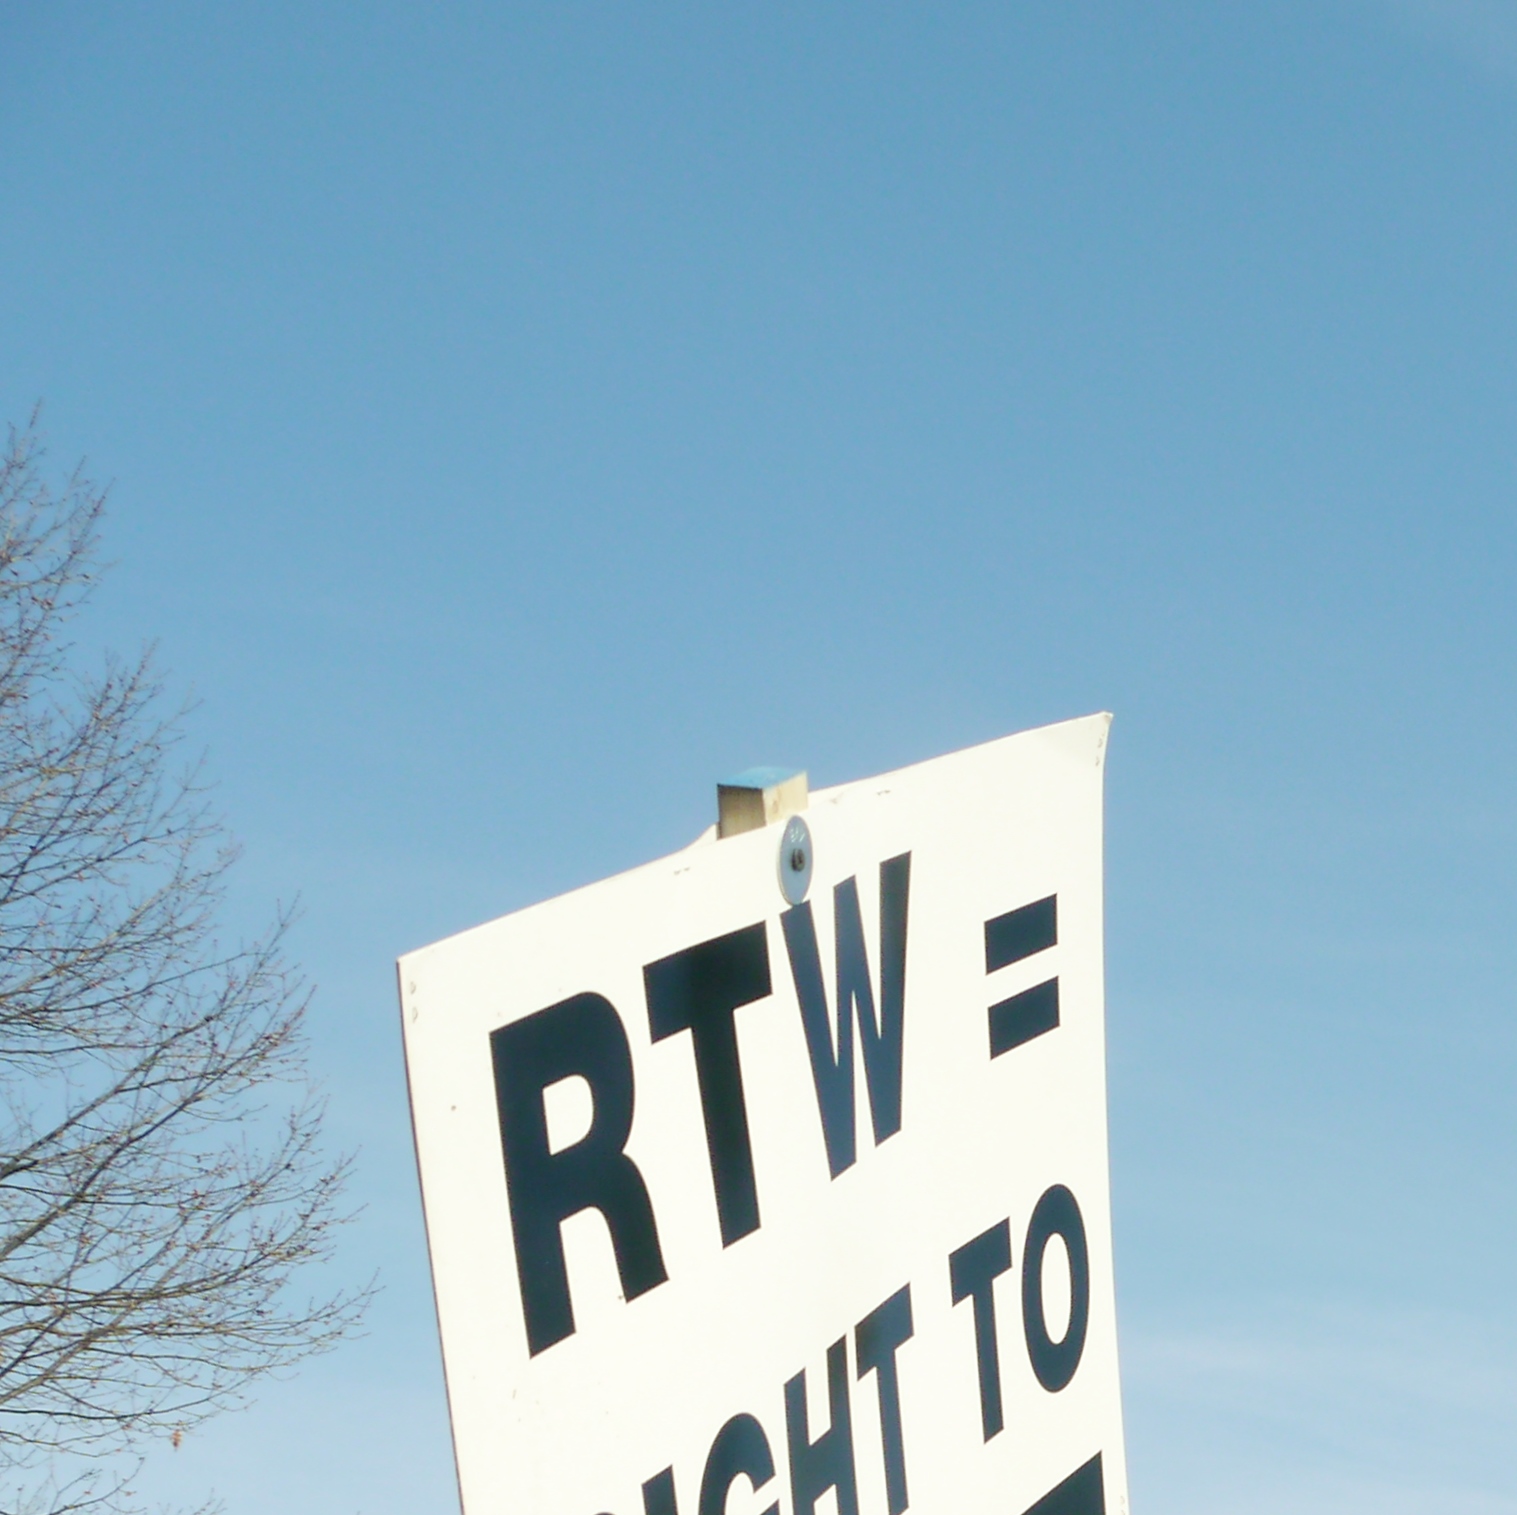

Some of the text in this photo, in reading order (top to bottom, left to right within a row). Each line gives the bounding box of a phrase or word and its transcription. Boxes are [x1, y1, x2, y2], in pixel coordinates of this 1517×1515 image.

[489, 850, 1061, 1360] RTW =
[948, 1183, 1090, 1445] TO
